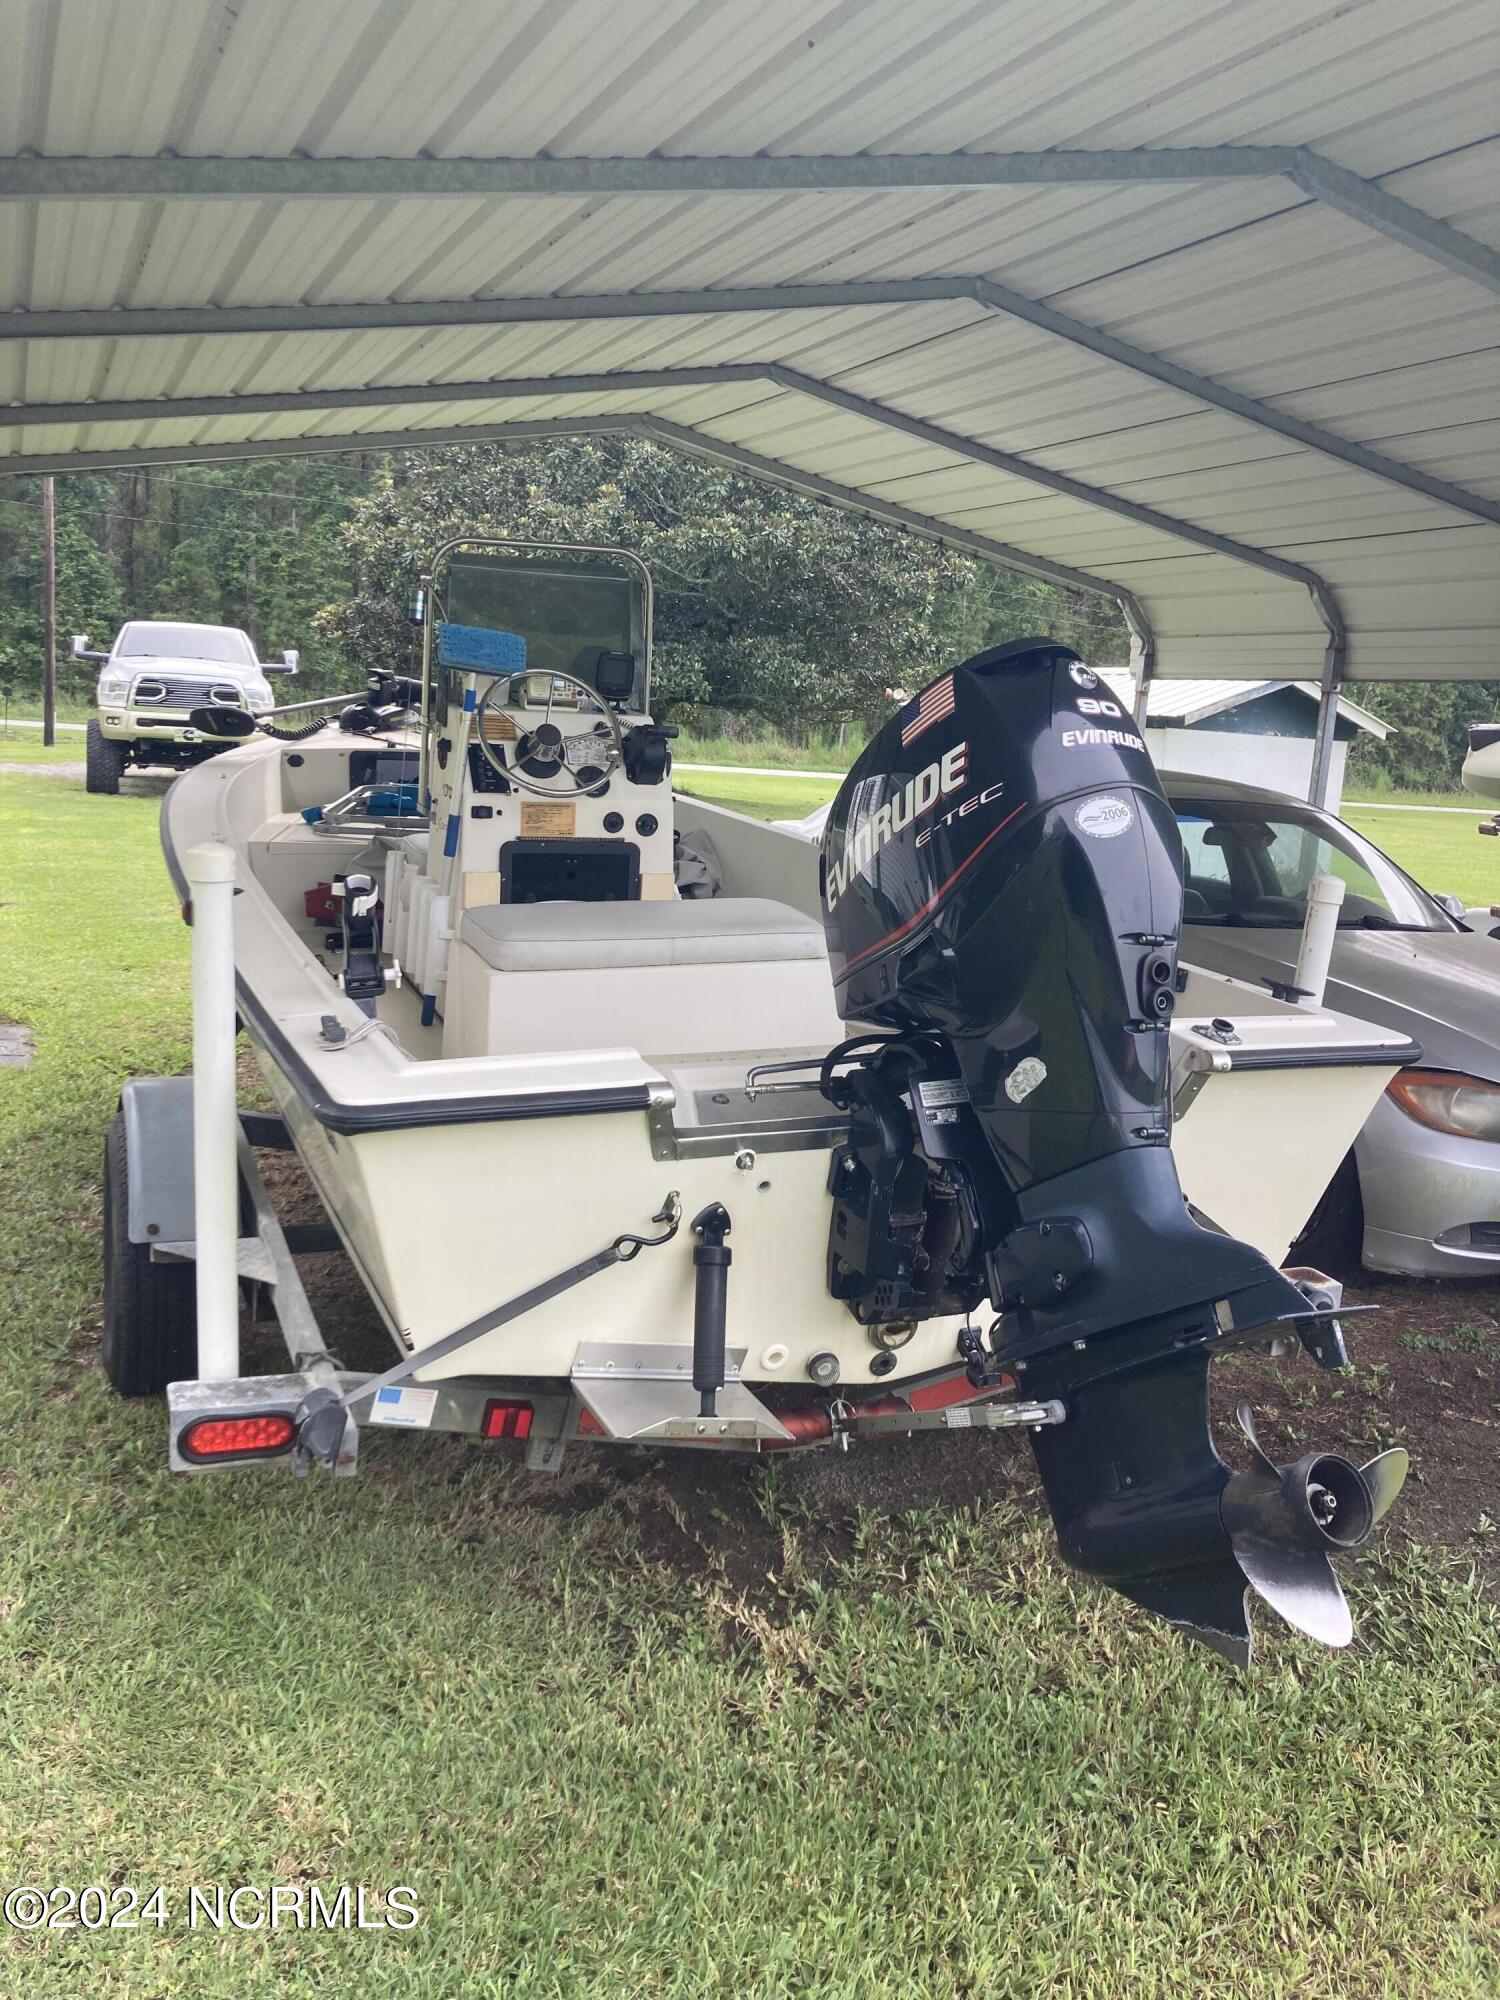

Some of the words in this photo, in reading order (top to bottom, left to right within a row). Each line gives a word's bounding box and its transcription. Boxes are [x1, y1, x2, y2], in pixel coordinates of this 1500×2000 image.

[1076, 698, 1122, 718] 90
[1062, 729, 1145, 753] EVINRUDE
[915, 782, 1003, 848] E-TEC
[1101, 807, 1129, 821] 2006
[826, 741, 968, 912] EVINRUDE
